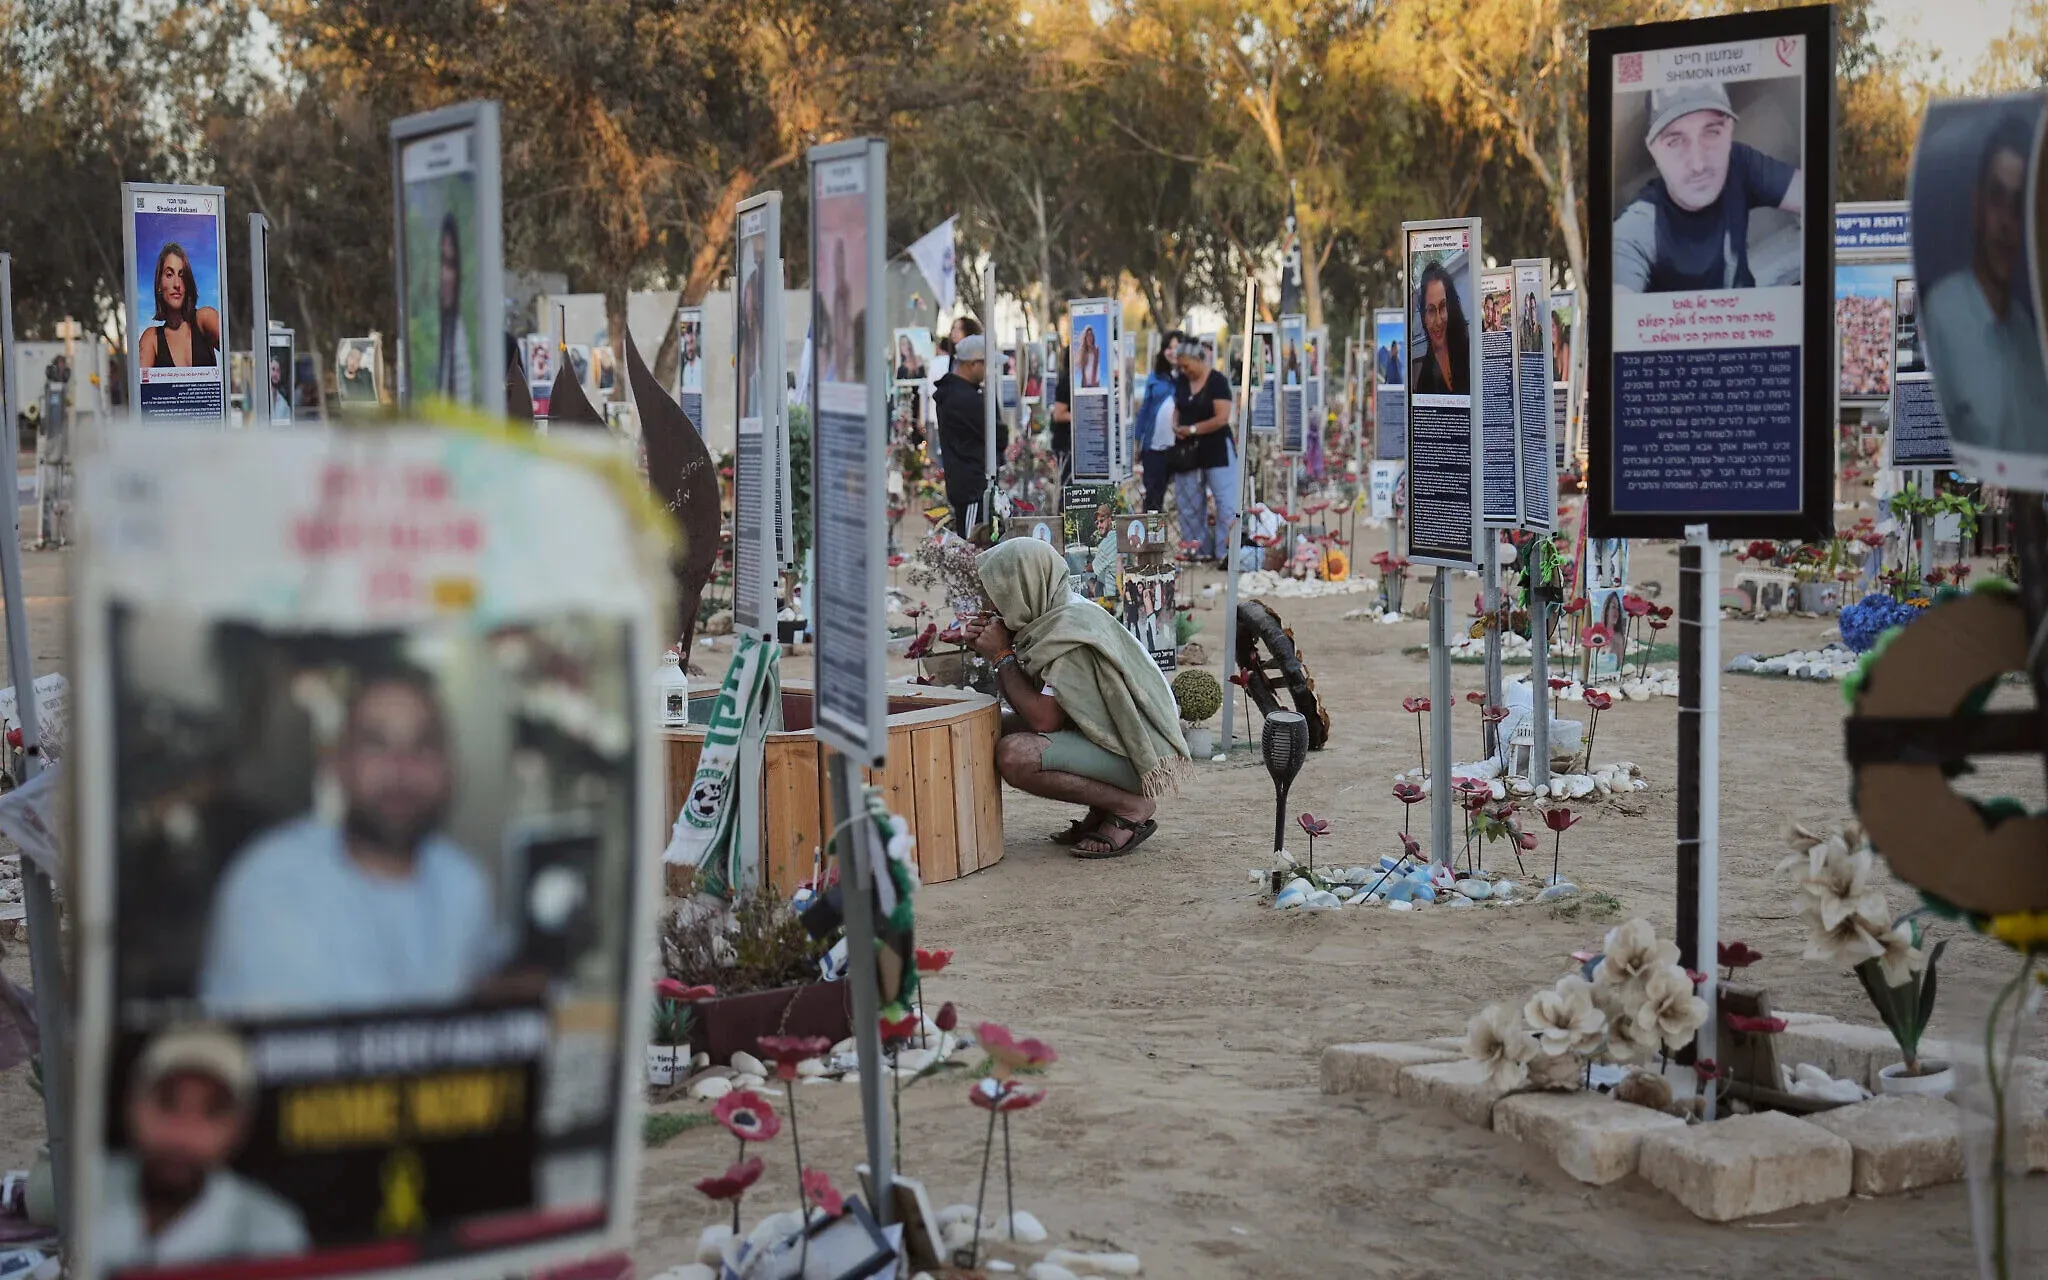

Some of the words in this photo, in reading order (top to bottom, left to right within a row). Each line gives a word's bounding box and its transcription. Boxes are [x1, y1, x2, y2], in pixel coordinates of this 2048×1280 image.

[1674, 51, 1701, 66] חייט
[1705, 47, 1744, 65] שמעון
[1666, 66, 1714, 82] SHIMON
[1716, 62, 1752, 77] HAYAT
[156, 205, 177, 213] Shaked
[1669, 313, 1687, 328] מלך
[1698, 314, 1723, 325] תהיה
[1727, 313, 1751, 323] תמיד
[1754, 310, 1776, 322] אתה
[1683, 332, 1700, 343] הכי
[1748, 328, 1774, 339] תמיד
